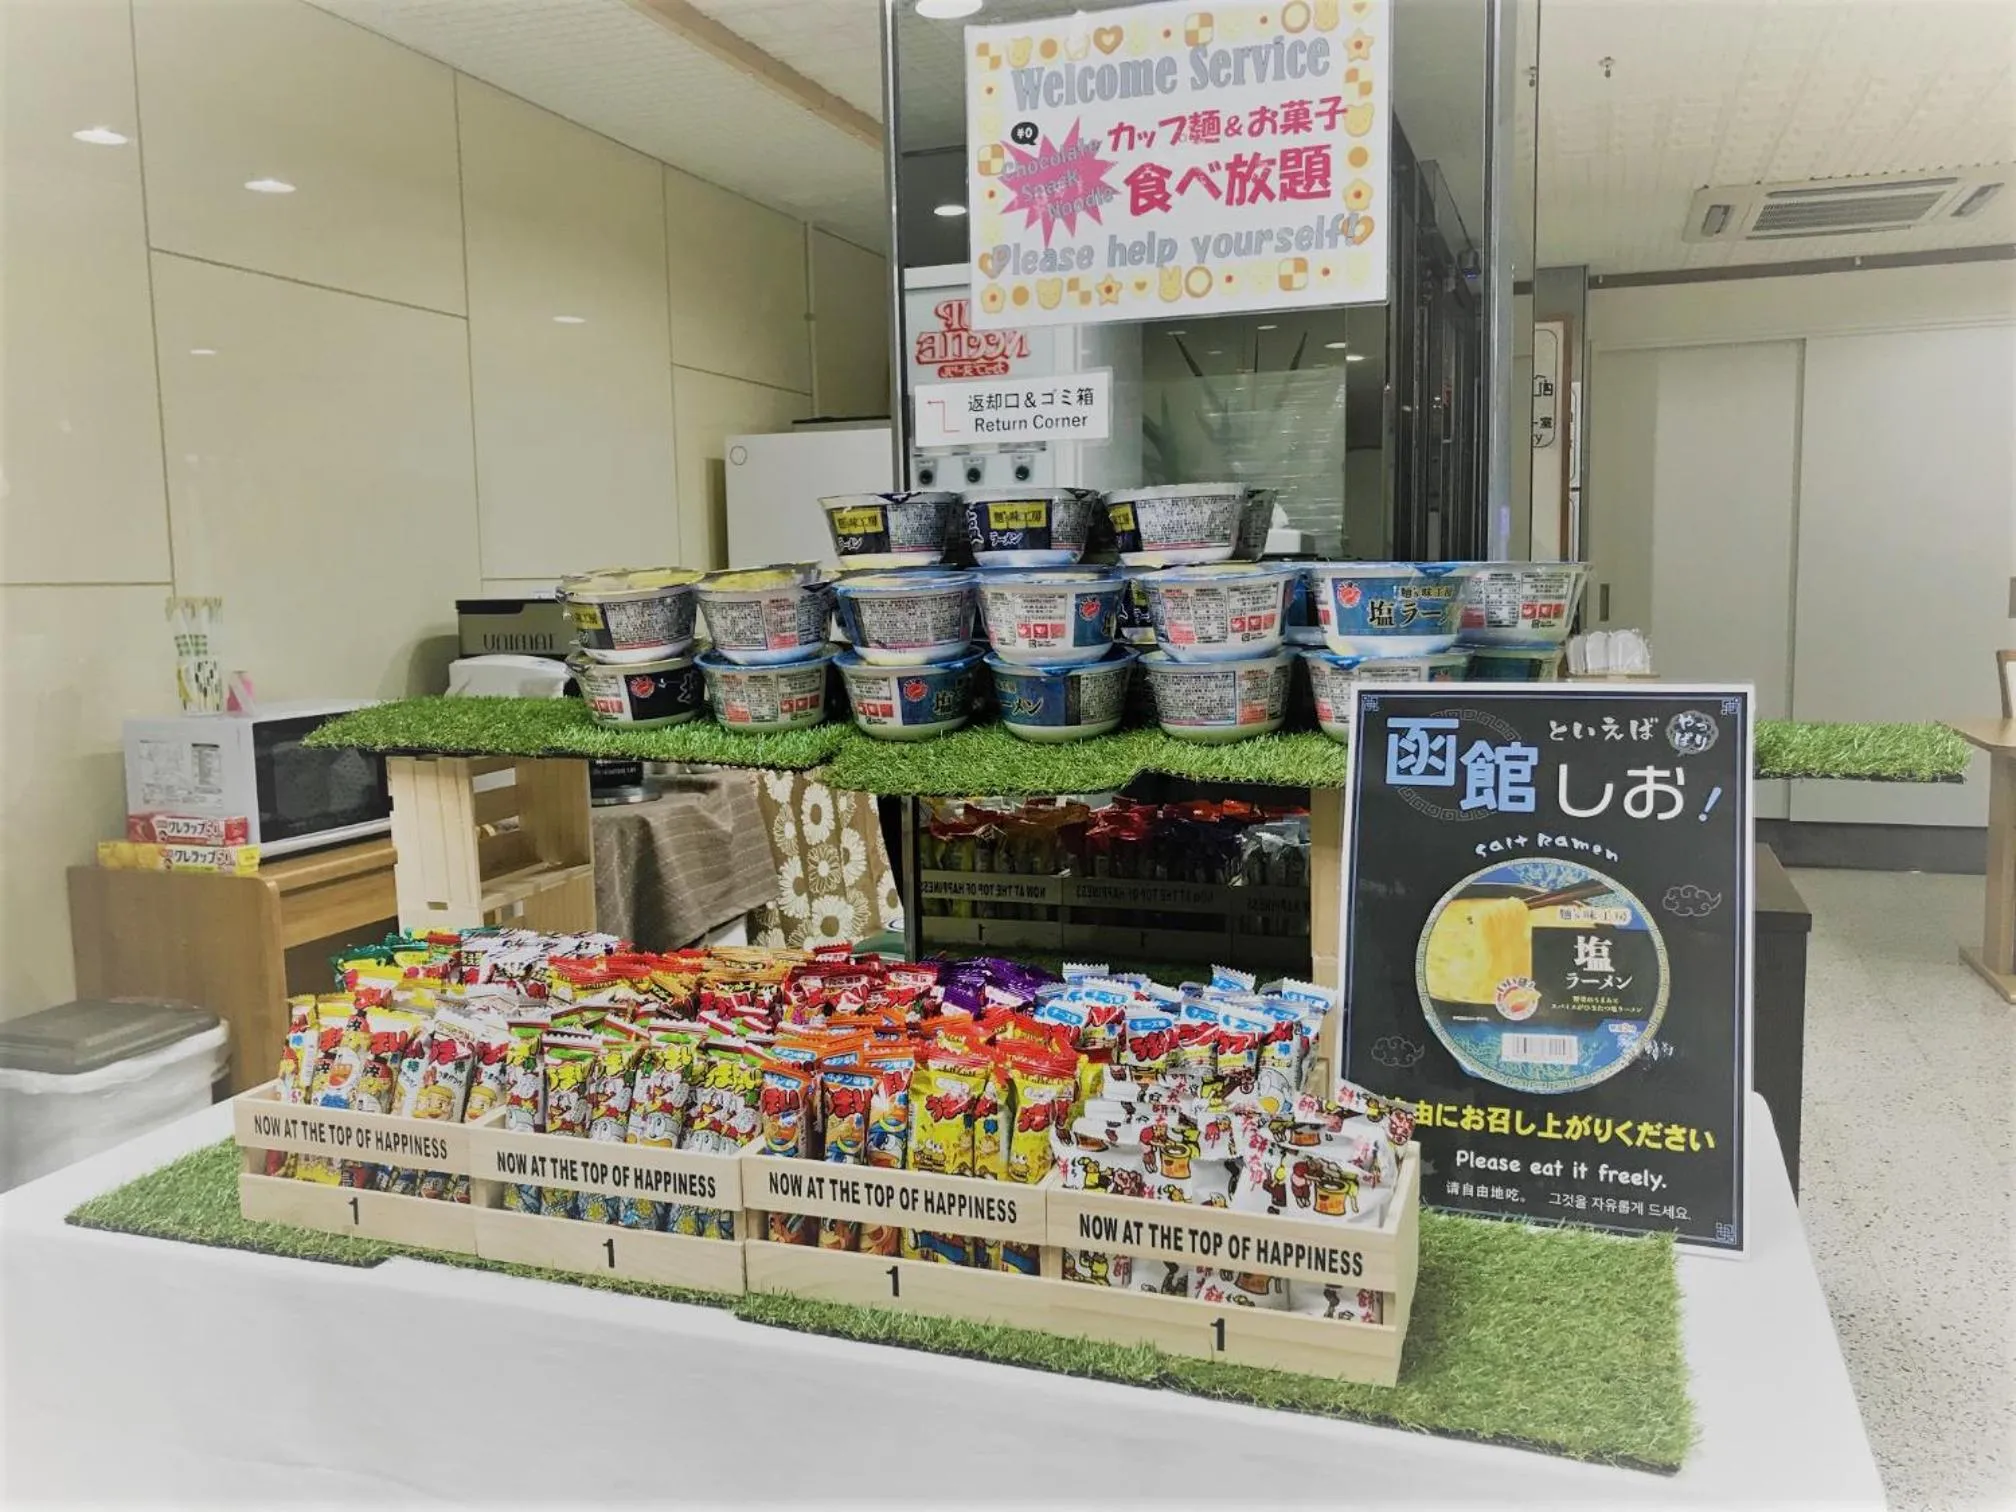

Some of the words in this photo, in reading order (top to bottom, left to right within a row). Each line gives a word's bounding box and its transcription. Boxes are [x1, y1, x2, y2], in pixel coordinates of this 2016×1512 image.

[1012, 62, 1178, 111] Welcome
[1190, 36, 1330, 91] Service
[1001, 137, 1102, 182] Chocolate
[1123, 145, 1332, 217] 食べ放題
[1047, 188, 1114, 219] Noodle
[990, 243, 1094, 279] Please
[1107, 232, 1178, 268] help
[1191, 212, 1361, 265] yourself!
[968, 387, 1094, 412] 返却口&ゴミ箱
[975, 416, 1028, 433] Return
[1033, 413, 1089, 430] Corner
[1548, 719, 1659, 743] といえば
[1386, 717, 1539, 814] 函館
[1574, 935, 1616, 973] 塩
[1565, 972, 1633, 990] ラーメン
[254, 1115, 281, 1136] NOW
[283, 1118, 299, 1138] AT
[300, 1120, 326, 1143] THE
[328, 1124, 353, 1147] TOP
[356, 1128, 371, 1149] OF
[374, 1131, 448, 1161] HAPPINESS
[1413, 1097, 1717, 1153] 由にお召し上がりください
[497, 1151, 527, 1175] NOW
[531, 1155, 547, 1178] AT
[550, 1157, 578, 1182] THE
[581, 1161, 609, 1185] TOP
[612, 1165, 630, 1187] OF
[632, 1168, 716, 1199] HAPPINESS
[1455, 1150, 1521, 1173] Please
[1530, 1159, 1564, 1178] eat
[1572, 1160, 1589, 1180] it
[1598, 1164, 1668, 1190] freely.
[348, 1197, 359, 1225] 1
[769, 1171, 803, 1197] NOW
[806, 1176, 825, 1200] AT
[829, 1178, 861, 1204] THE
[864, 1182, 896, 1208] TOP
[899, 1187, 919, 1211] OF
[924, 1190, 1017, 1224] HAPPINESS
[1446, 1181, 1526, 1204] 请自由地吃。
[1548, 1191, 1588, 1211] 그것을
[1591, 1195, 1645, 1217] 자유롭게
[602, 1238, 615, 1269] 1
[1079, 1213, 1118, 1242] NOW
[1122, 1219, 1144, 1246] AT
[1148, 1223, 1184, 1252] THE
[1188, 1228, 1224, 1257] TOP
[1228, 1234, 1250, 1261] OF
[1255, 1238, 1363, 1280] HAPPINESS
[886, 1265, 900, 1297] 1
[1210, 1318, 1227, 1352] 1
